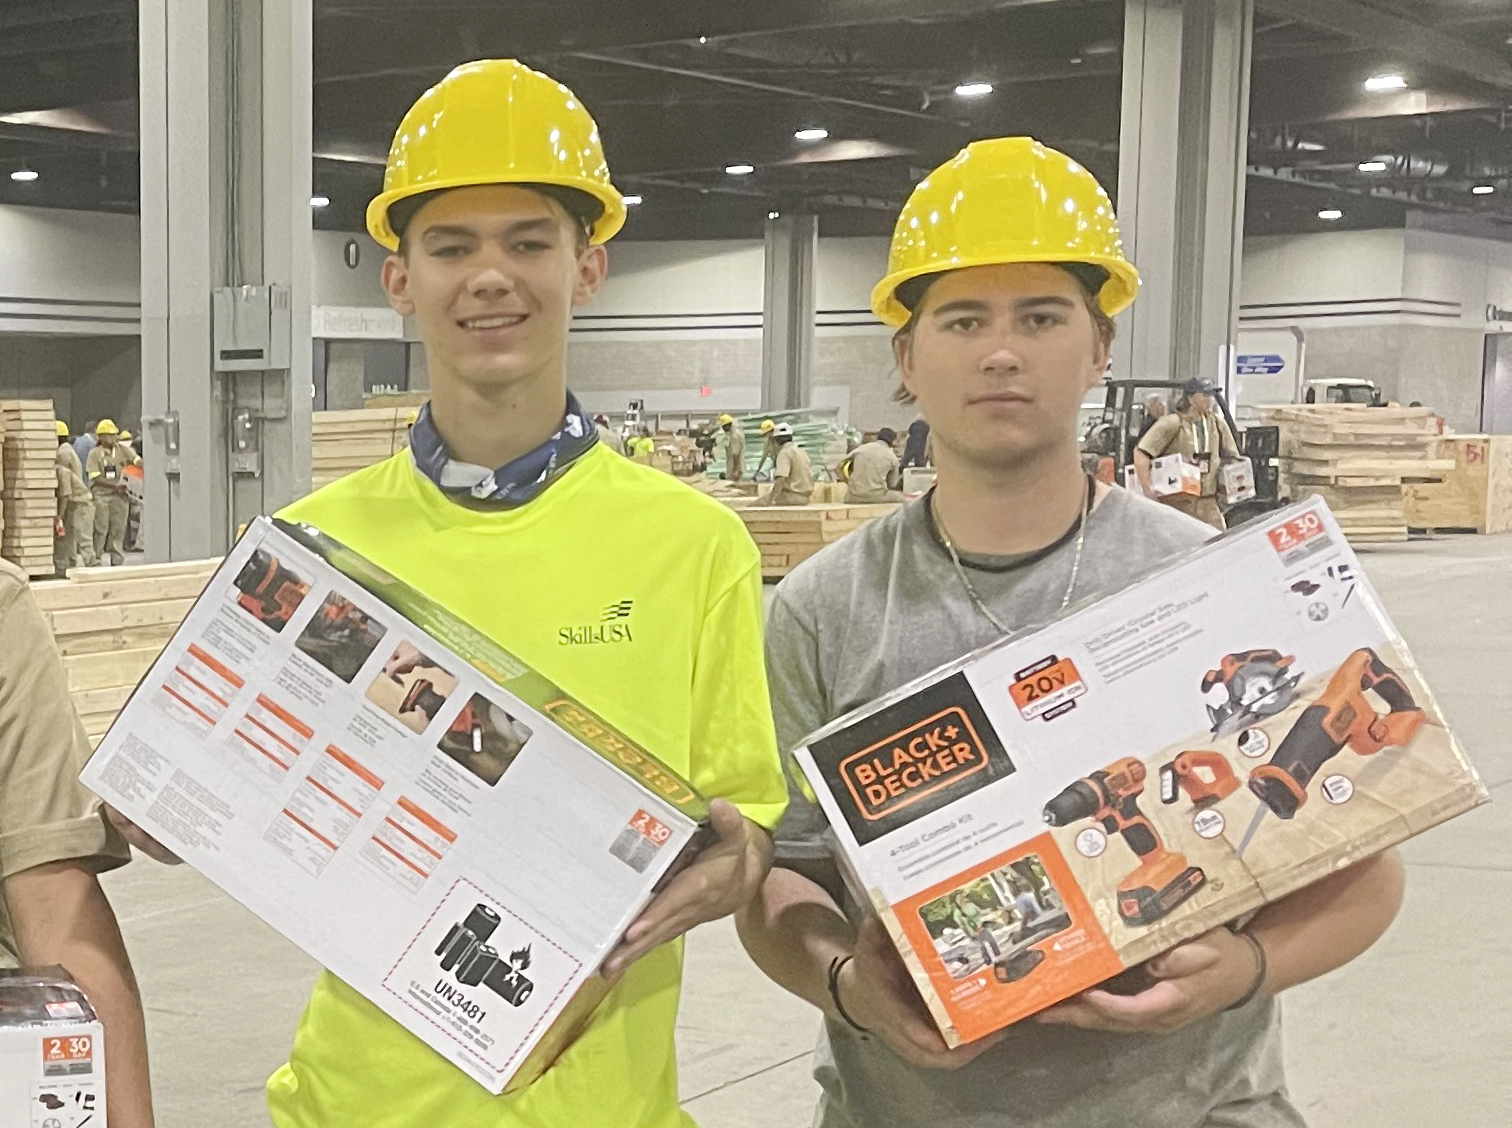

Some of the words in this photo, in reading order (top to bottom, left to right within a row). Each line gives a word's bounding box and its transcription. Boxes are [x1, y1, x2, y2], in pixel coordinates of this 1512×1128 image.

[1275, 528, 1292, 543] 2
[1294, 513, 1319, 534] 30
[558, 624, 633, 646] SkillsUSA
[854, 724, 960, 786] BLACK+
[865, 742, 976, 807] DECKER
[651, 822, 671, 842] 30
[434, 978, 487, 1024] UN3481
[50, 1039, 61, 1054] 2
[69, 1037, 91, 1053] 30
